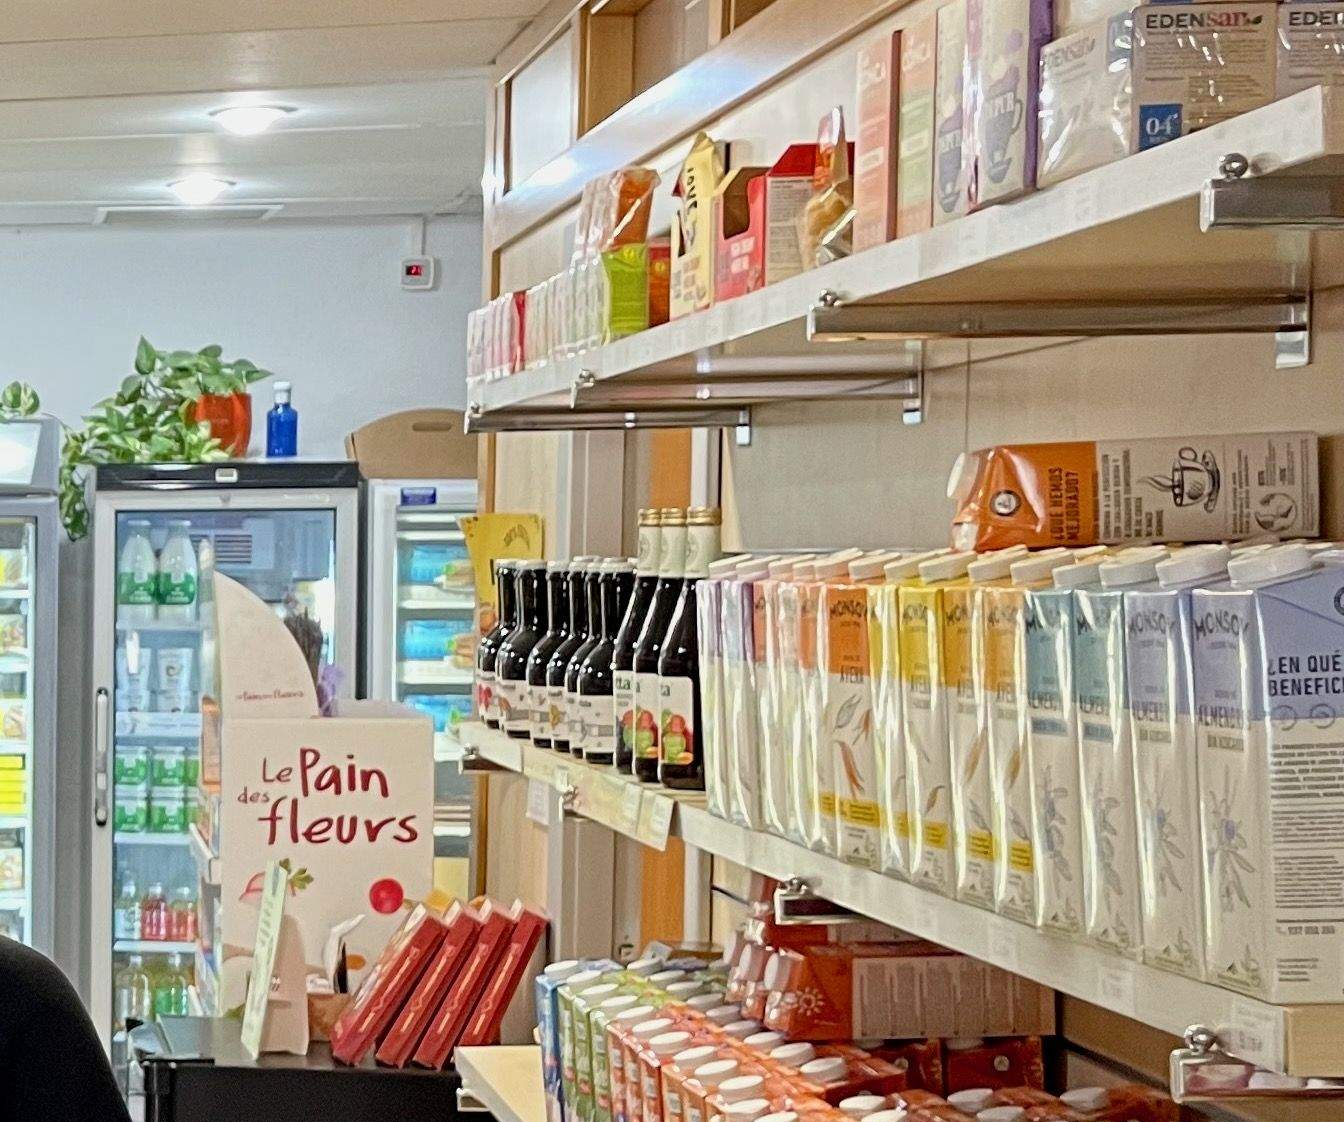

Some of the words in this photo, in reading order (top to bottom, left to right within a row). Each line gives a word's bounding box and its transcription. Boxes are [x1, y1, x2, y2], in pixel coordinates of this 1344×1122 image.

[1308, 650, 1342, 673] QUÉ
[262, 757, 293, 784] Le
[299, 747, 389, 799] Pain
[237, 786, 270, 804] des
[257, 796, 418, 845] fleurs
